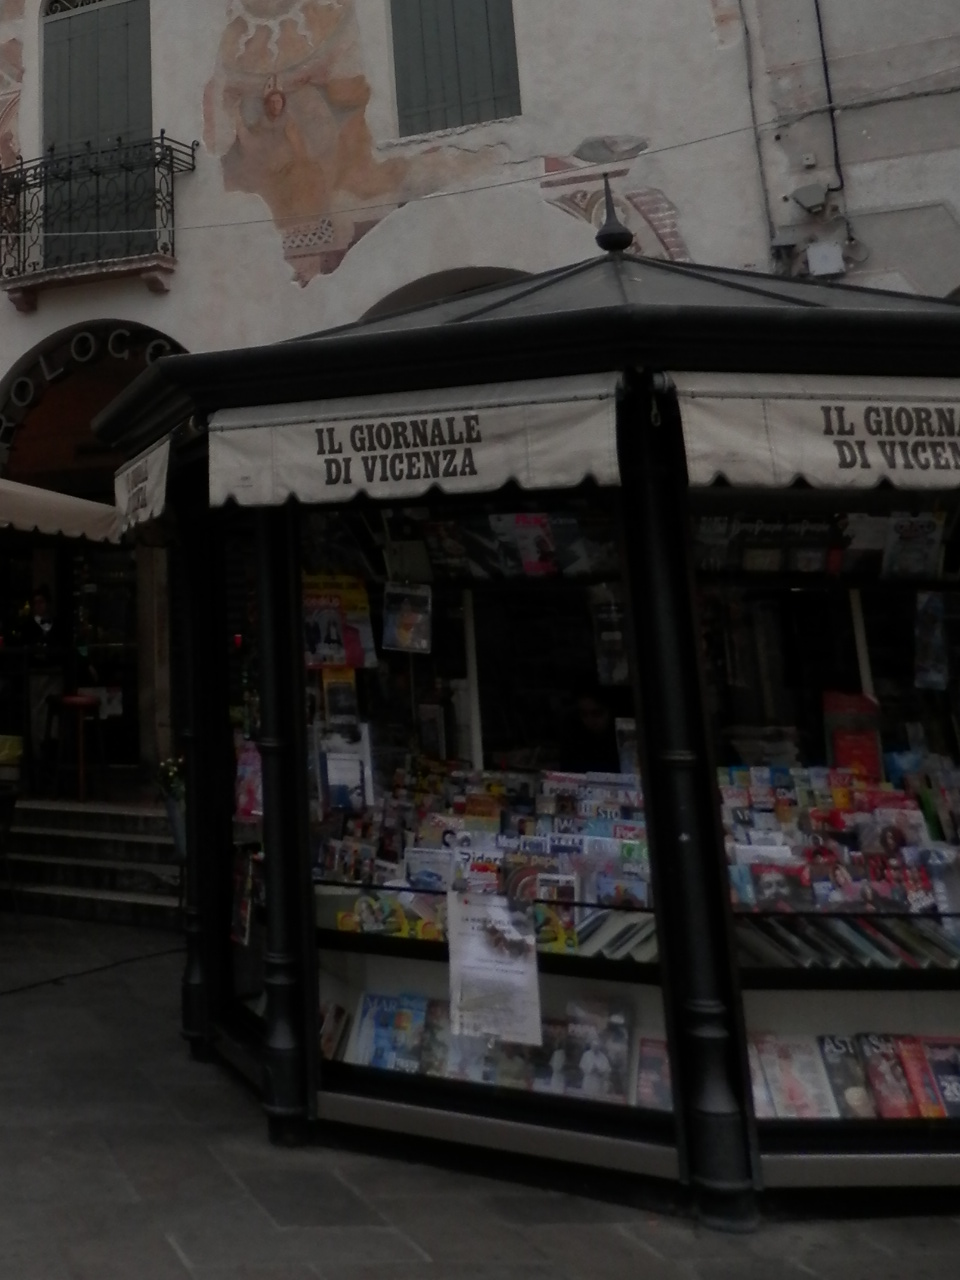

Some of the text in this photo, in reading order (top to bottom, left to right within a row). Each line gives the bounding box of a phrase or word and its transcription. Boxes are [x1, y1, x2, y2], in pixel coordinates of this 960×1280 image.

[315, 414, 483, 456] IL GIORNALE
[820, 405, 856, 437] IL
[323, 448, 479, 486] DI VICENZA
[832, 439, 872, 470] DI
